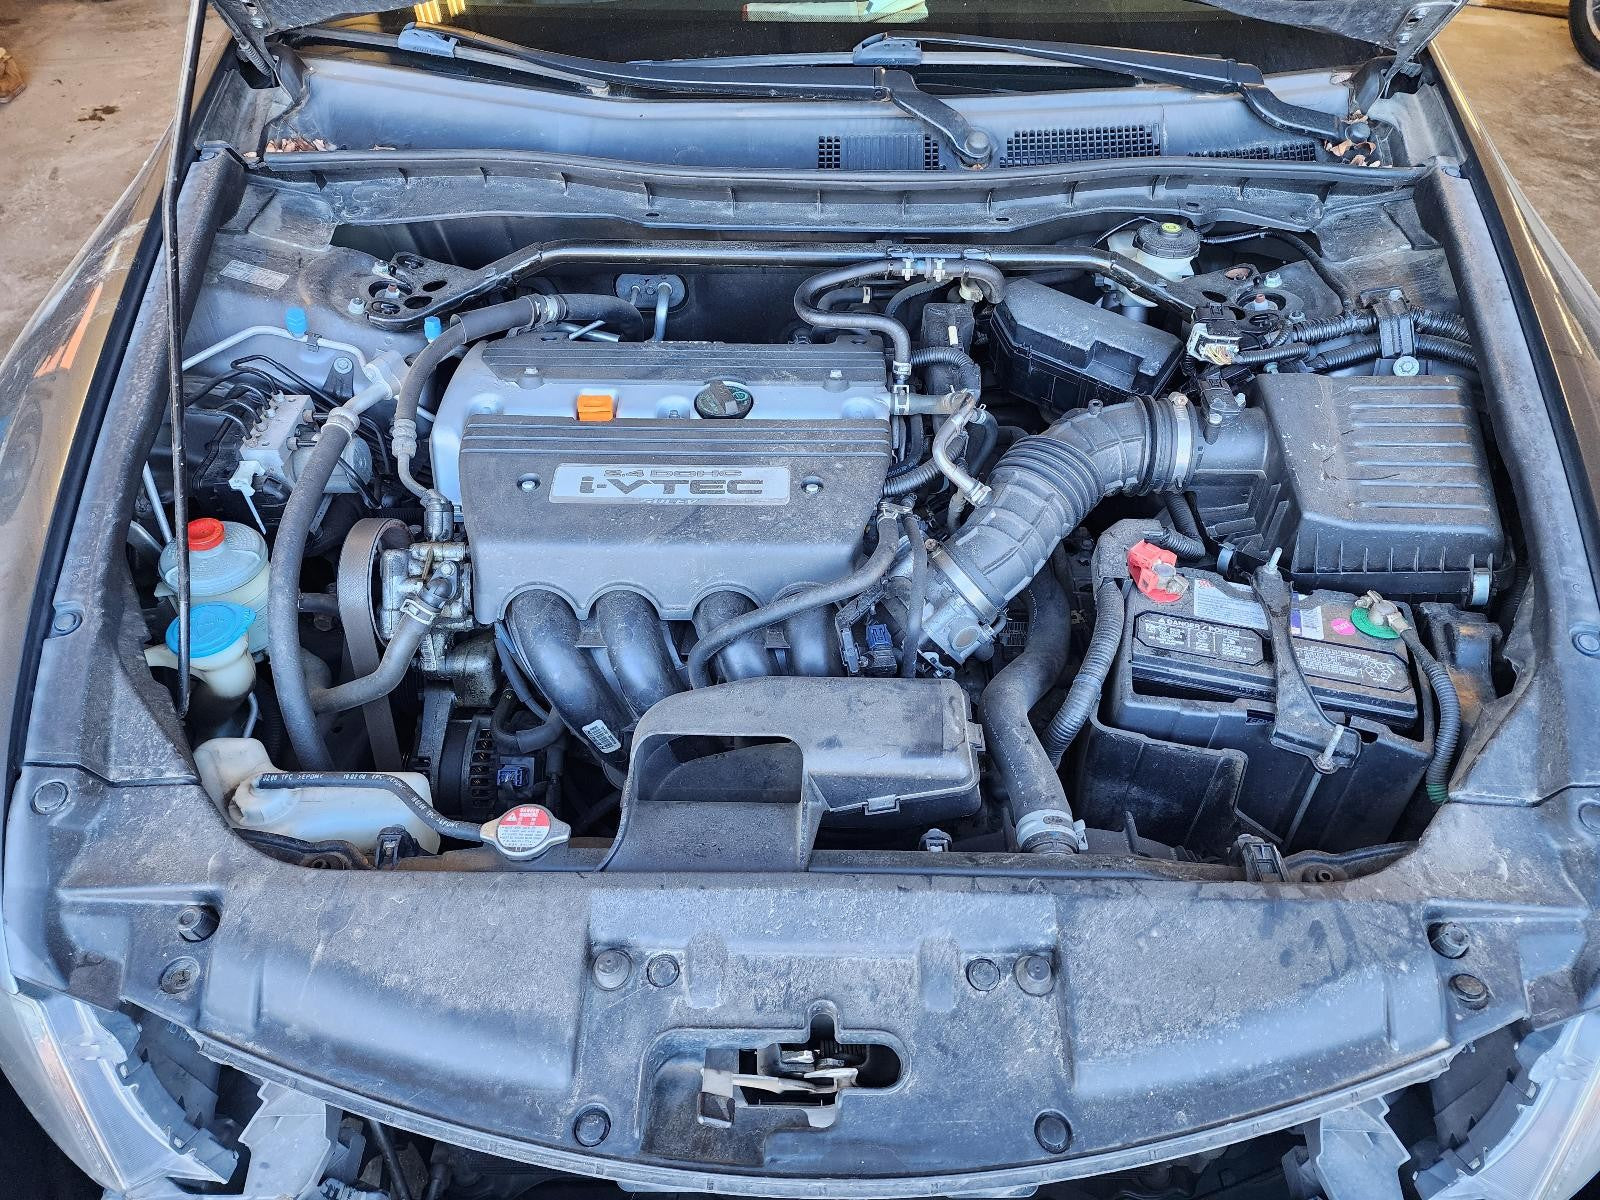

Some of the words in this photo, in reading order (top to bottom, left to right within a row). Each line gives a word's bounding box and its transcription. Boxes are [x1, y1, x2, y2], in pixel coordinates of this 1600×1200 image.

[604, 470, 645, 478] 2.4
[649, 470, 742, 478] DOHC
[580, 476, 764, 495] i-VTEC
